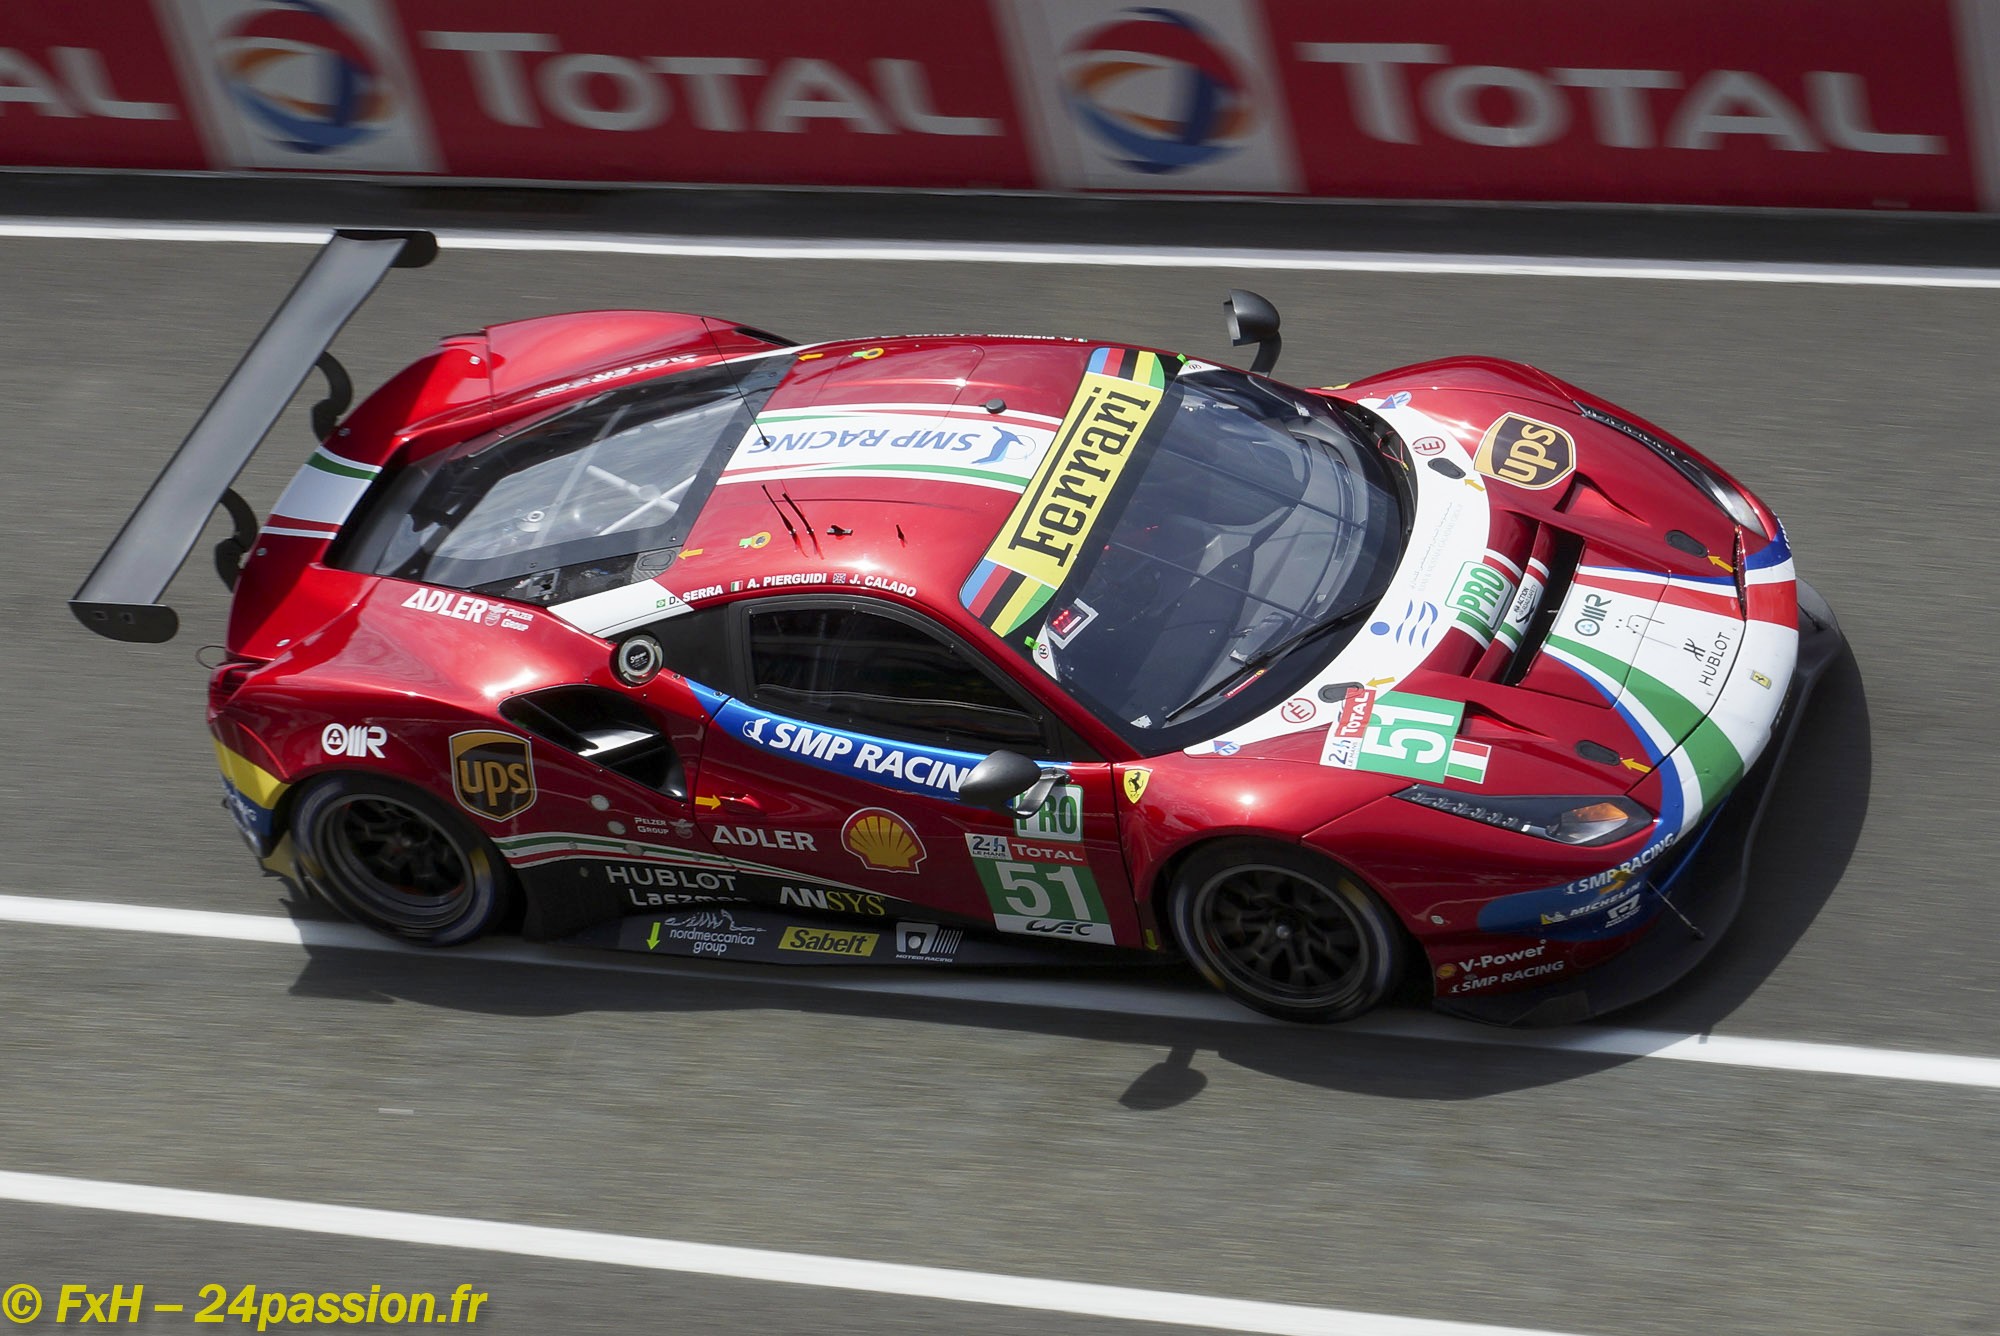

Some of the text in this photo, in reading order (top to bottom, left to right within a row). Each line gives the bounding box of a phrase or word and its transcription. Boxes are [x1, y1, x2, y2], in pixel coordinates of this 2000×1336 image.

[420, 31, 1005, 136] TOTAL
[1295, 42, 1949, 155] TOTAL
[747, 429, 982, 454] SMP RACING
[1008, 387, 1151, 567] Ferrari
[669, 584, 723, 605] D. SERRA
[747, 573, 827, 588] A. PIERGUIDI
[850, 575, 917, 597] J. CALADO
[1456, 567, 1505, 622] PRO
[401, 587, 489, 623] ADLER
[1699, 631, 1731, 687] HUBLOT
[1340, 692, 1369, 736] TOTAL
[1362, 704, 1455, 764] 51
[769, 723, 971, 793] SMP RACIN
[460, 757, 530, 806] ups
[634, 817, 667, 826] PELZER
[637, 826, 669, 834] GROUP
[712, 825, 817, 851] ADLER
[1012, 844, 1083, 862] TOTAL
[1578, 832, 1675, 893] SMP RACING
[605, 865, 736, 891] HUBLOT
[995, 861, 1092, 921] 51
[779, 886, 885, 916] ANSYS
[669, 928, 755, 946] nordmeccanica
[790, 930, 868, 955] Sabelt
[1026, 920, 1093, 936] WEC
[693, 941, 728, 955] group
[1459, 944, 1545, 973] V-Power
[1461, 960, 1564, 993] SMP RACING
